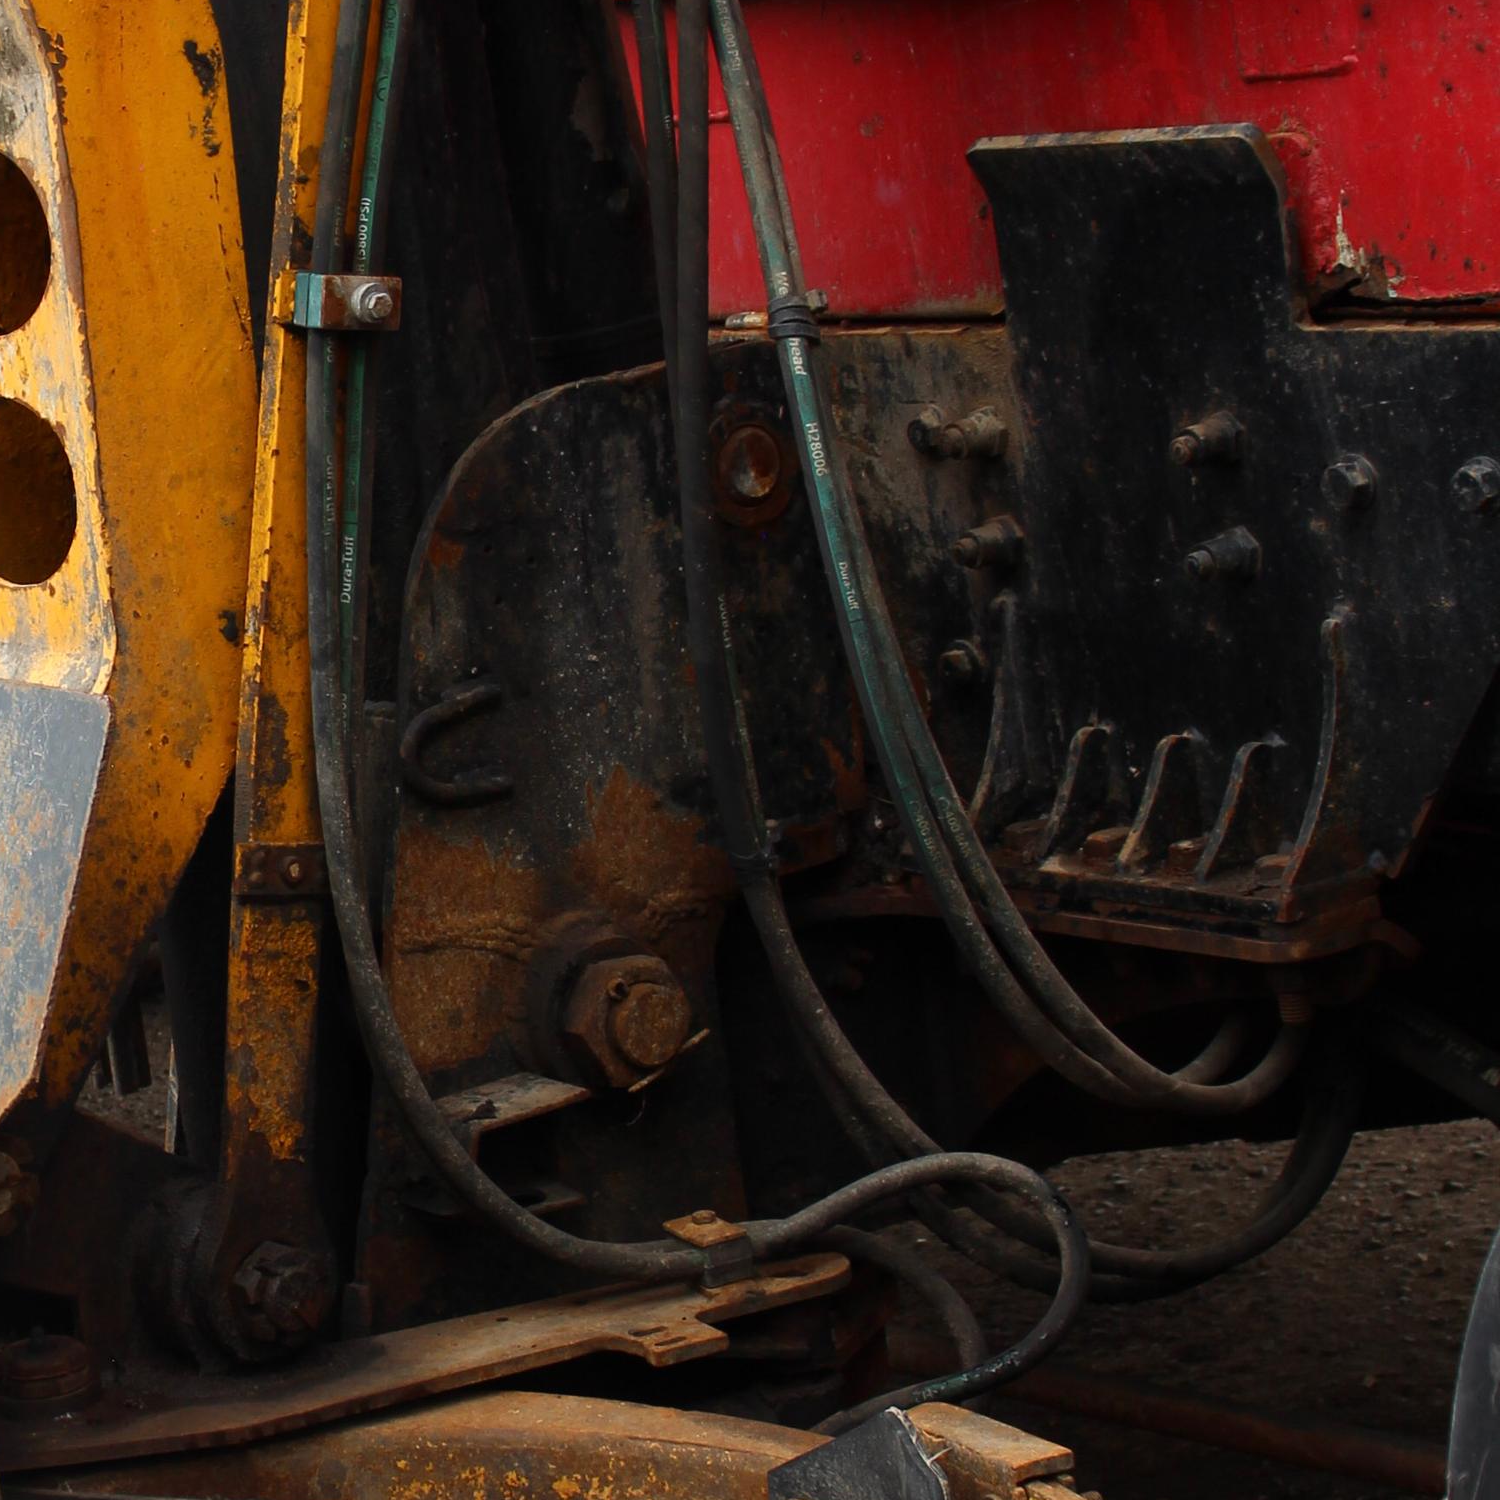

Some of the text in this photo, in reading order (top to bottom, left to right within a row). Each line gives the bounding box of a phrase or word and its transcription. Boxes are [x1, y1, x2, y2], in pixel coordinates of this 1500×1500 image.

[359, 197, 372, 221] PSI)
[356, 223, 369, 260] (5800
[805, 420, 828, 477] H28006
[340, 534, 355, 604] Dura-Tuff
[838, 560, 861, 612] Dura-Tuff
